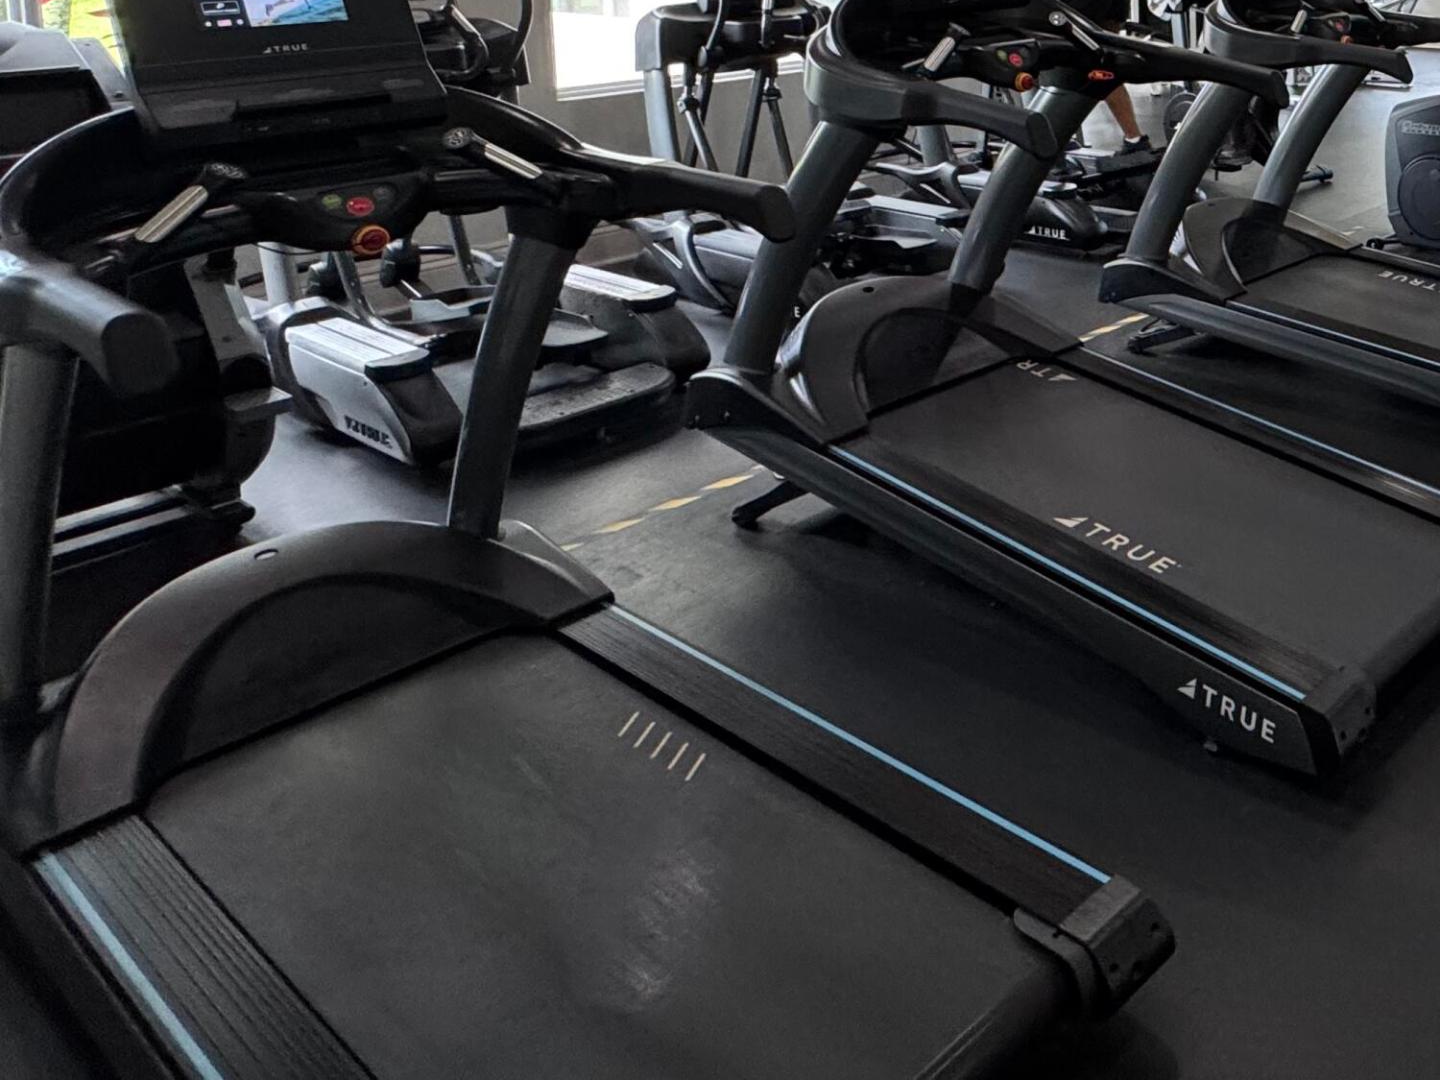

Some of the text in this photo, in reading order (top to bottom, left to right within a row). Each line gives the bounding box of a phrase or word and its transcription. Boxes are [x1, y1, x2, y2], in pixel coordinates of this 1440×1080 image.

[273, 43, 309, 53] TRUE
[1037, 226, 1066, 240] TRUE
[1085, 522, 1177, 574] TRUE
[1202, 683, 1276, 744] TRUE
